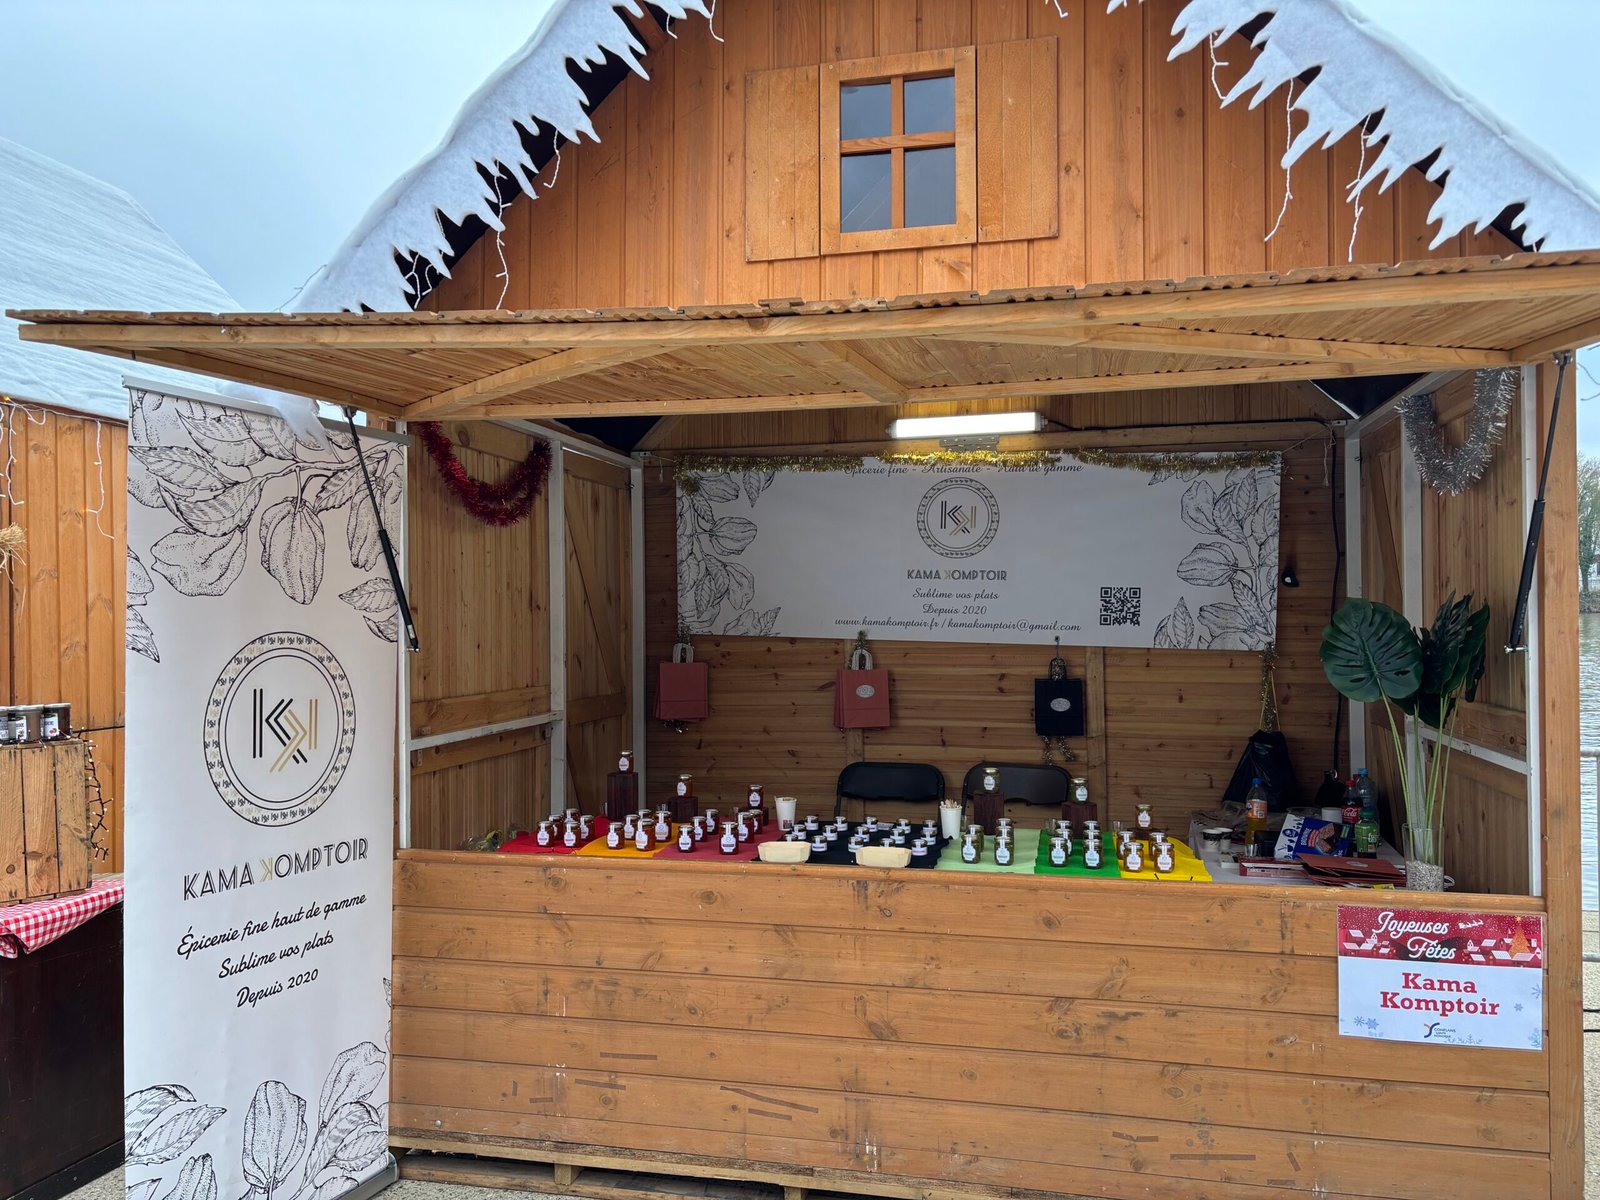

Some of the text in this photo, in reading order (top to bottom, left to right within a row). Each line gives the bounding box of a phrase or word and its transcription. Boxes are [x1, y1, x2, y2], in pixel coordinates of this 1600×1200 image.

[887, 463, 909, 477] fine
[1044, 464, 1084, 475] gamme
[907, 569, 1007, 581] KAMA KOMPTOIR
[912, 587, 1000, 601] Sublime vos plats
[922, 603, 988, 617] Depuis 2020
[183, 837, 369, 901] KAMA KOMPTOIR
[177, 894, 367, 960] Épicerie fine haut de gamme
[1372, 911, 1449, 939] Joyeuses
[218, 930, 334, 979] Sublime vos plats
[1407, 936, 1456, 960] Fêtes
[236, 968, 319, 1008] Depuis 2020
[1401, 972, 1478, 994] Kama
[1380, 991, 1500, 1017] Komptoir
